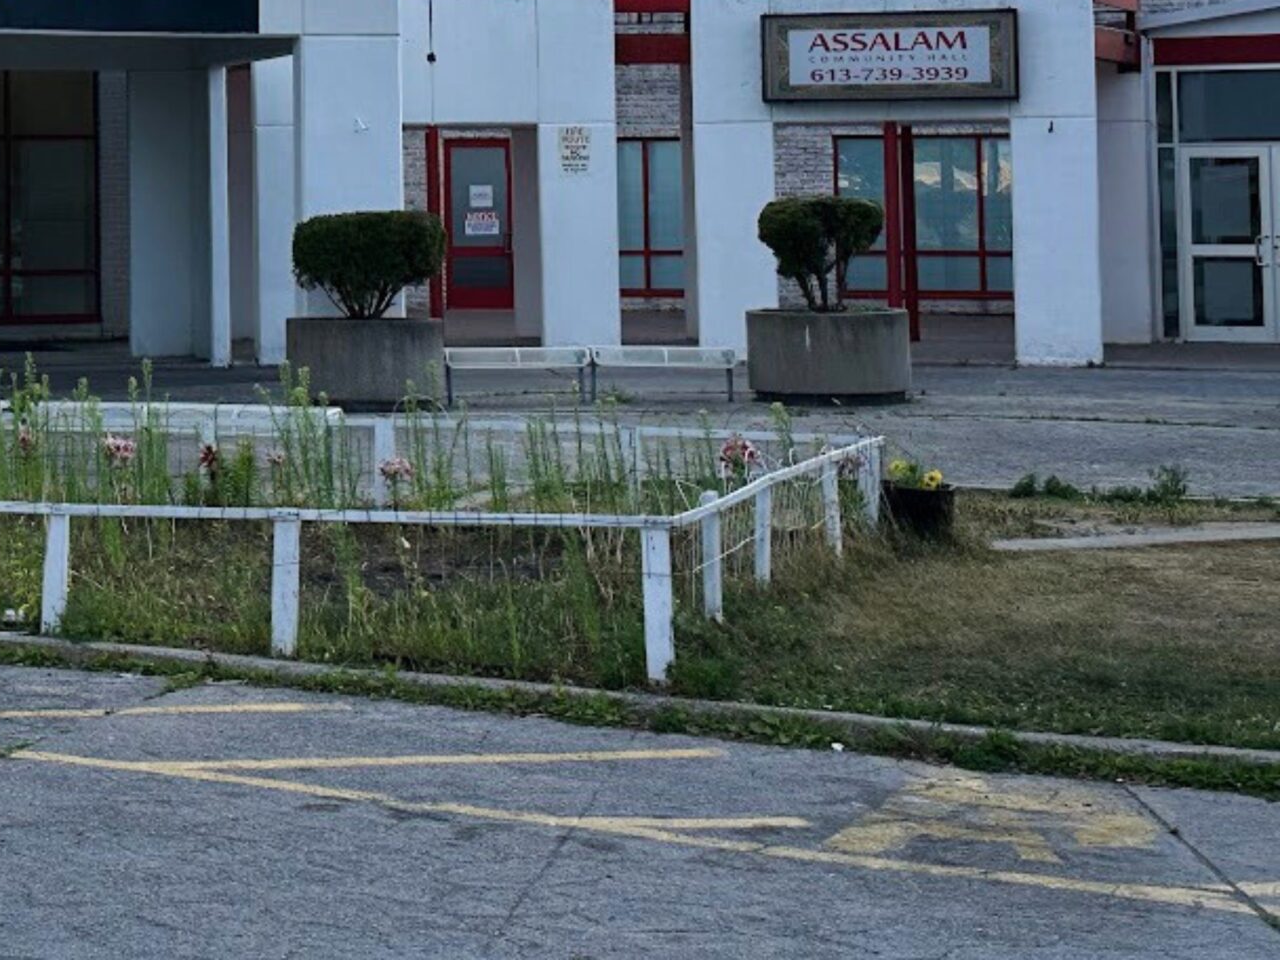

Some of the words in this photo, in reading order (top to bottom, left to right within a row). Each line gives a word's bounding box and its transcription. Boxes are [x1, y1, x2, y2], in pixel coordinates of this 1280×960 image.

[808, 31, 968, 53] ASSALAM
[808, 54, 915, 64] COMMUNITY
[927, 53, 968, 63] HALL
[810, 67, 969, 83] 613-739-3939
